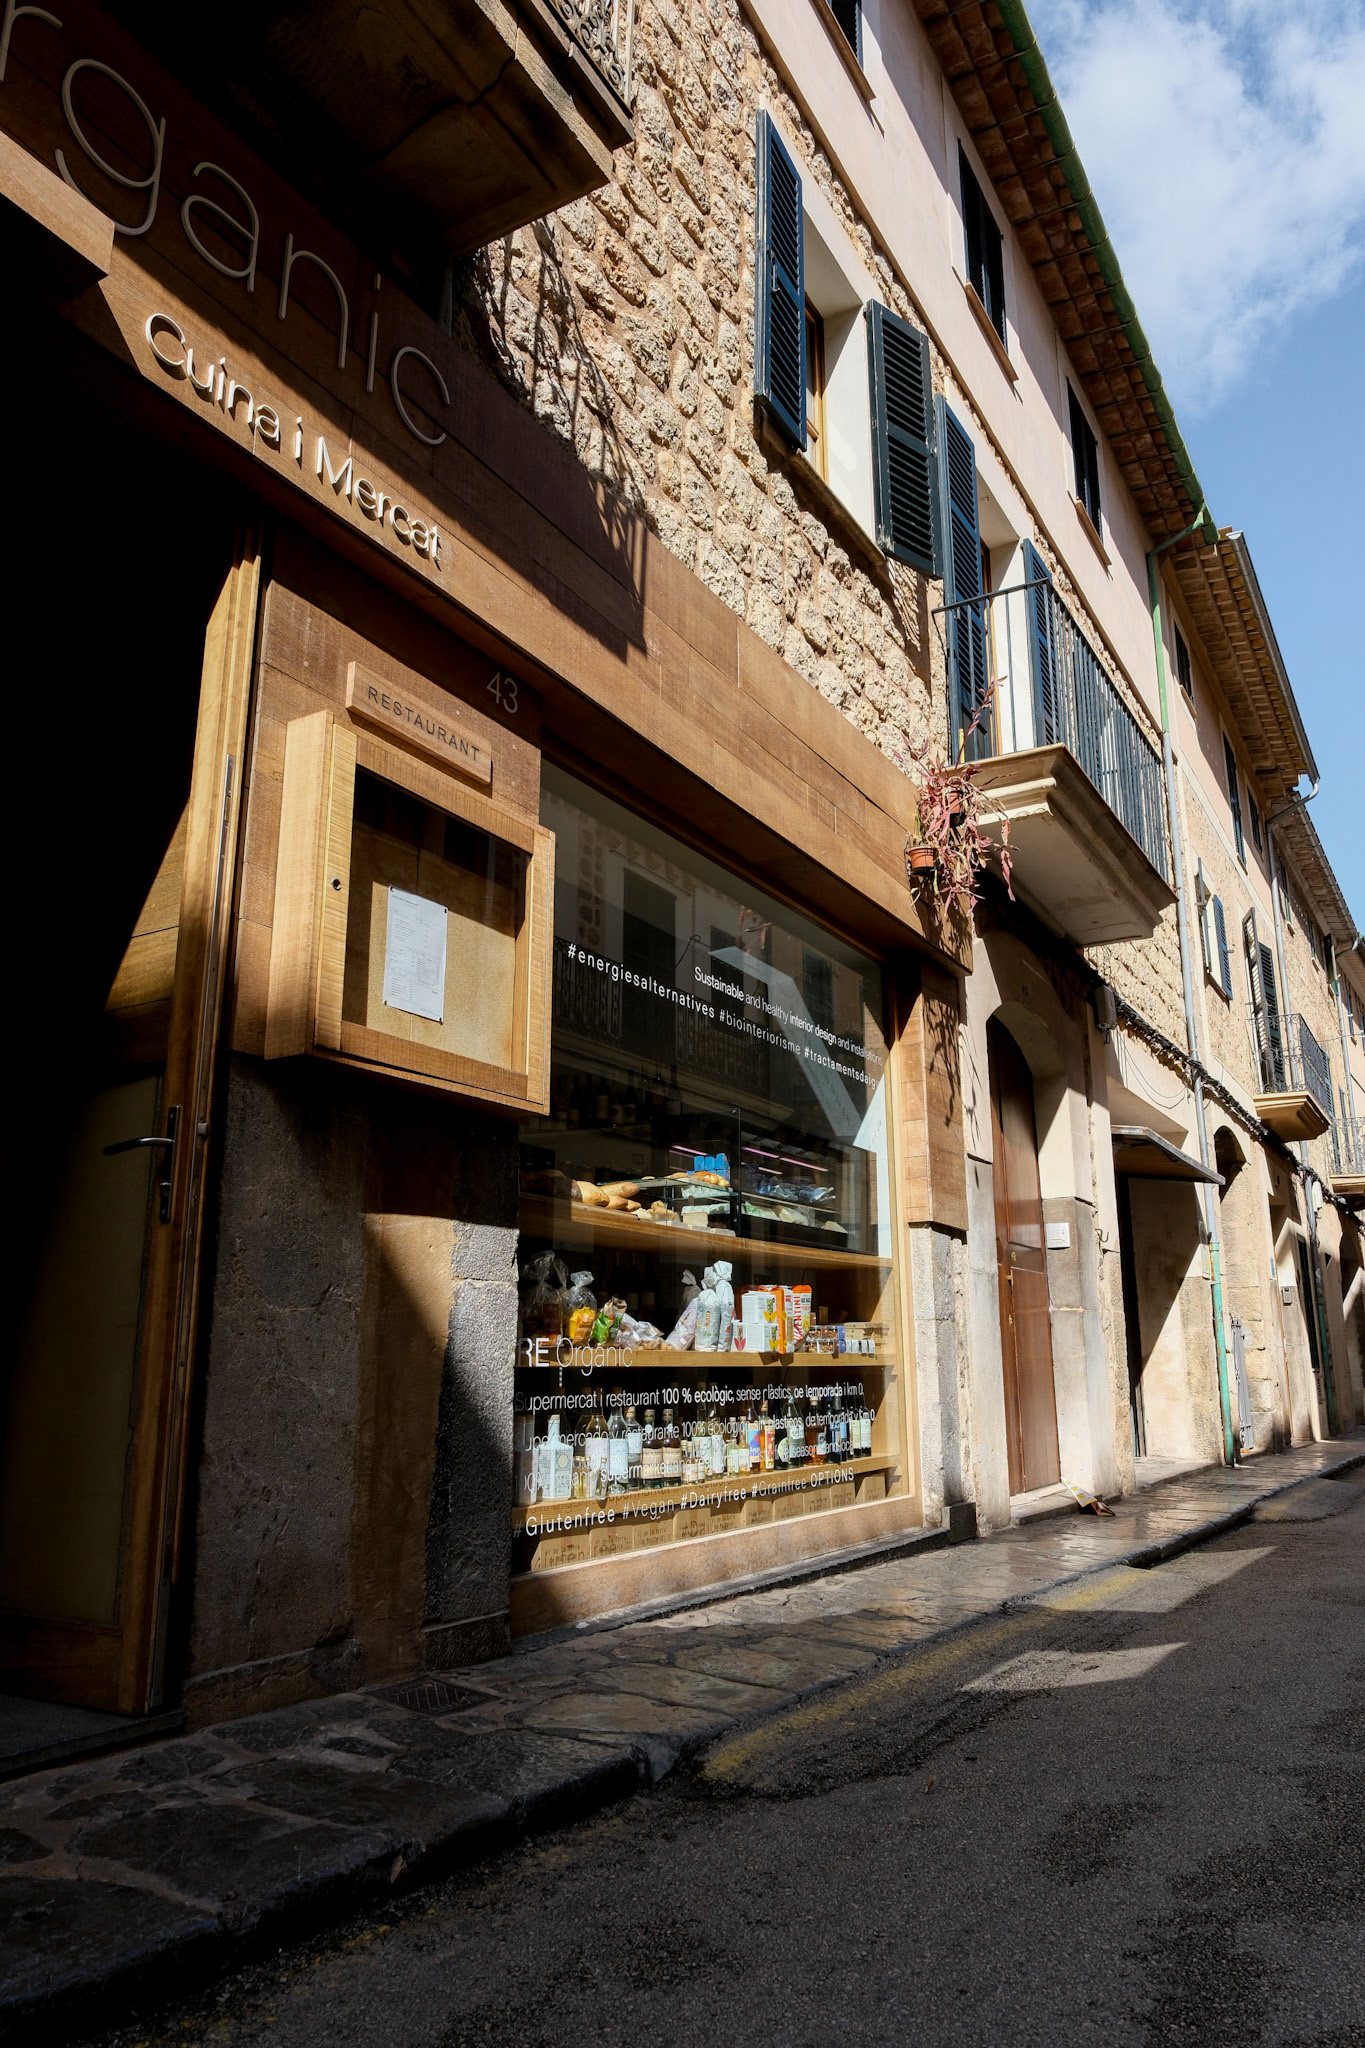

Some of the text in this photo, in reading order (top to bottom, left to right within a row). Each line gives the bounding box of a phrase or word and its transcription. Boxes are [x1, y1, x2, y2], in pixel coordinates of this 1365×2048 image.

[145, 312, 441, 562] Cuina i Mercat
[367, 684, 480, 761] RESTAURANT
[486, 671, 519, 715] 43
[567, 942, 715, 1019] #energiesalternatives
[719, 1008, 801, 1056] #biointeriorisme
[694, 966, 745, 1002] Sustainable
[745, 993, 761, 1009] and
[761, 997, 789, 1025] healthy
[789, 1010, 814, 1034] interior
[814, 1023, 837, 1046] design
[837, 1036, 850, 1051] and
[556, 1335, 633, 1377] Organic
[514, 1389, 598, 1416] Supermercat
[605, 1388, 661, 1408] restaurant
[661, 1387, 680, 1405] 100
[681, 1387, 693, 1404] %
[694, 1384, 735, 1407] ecològic,
[736, 1387, 761, 1402] sense
[805, 1382, 843, 1402] temporada
[847, 1382, 858, 1396] km
[681, 1420, 706, 1438] 100%
[513, 1506, 616, 1539] #Glutenfree
[622, 1498, 675, 1520] #Vegan
[680, 1485, 747, 1510] #Dairyfree
[752, 1475, 807, 1498] #Grainfree
[810, 1466, 855, 1488] OPTIONS
